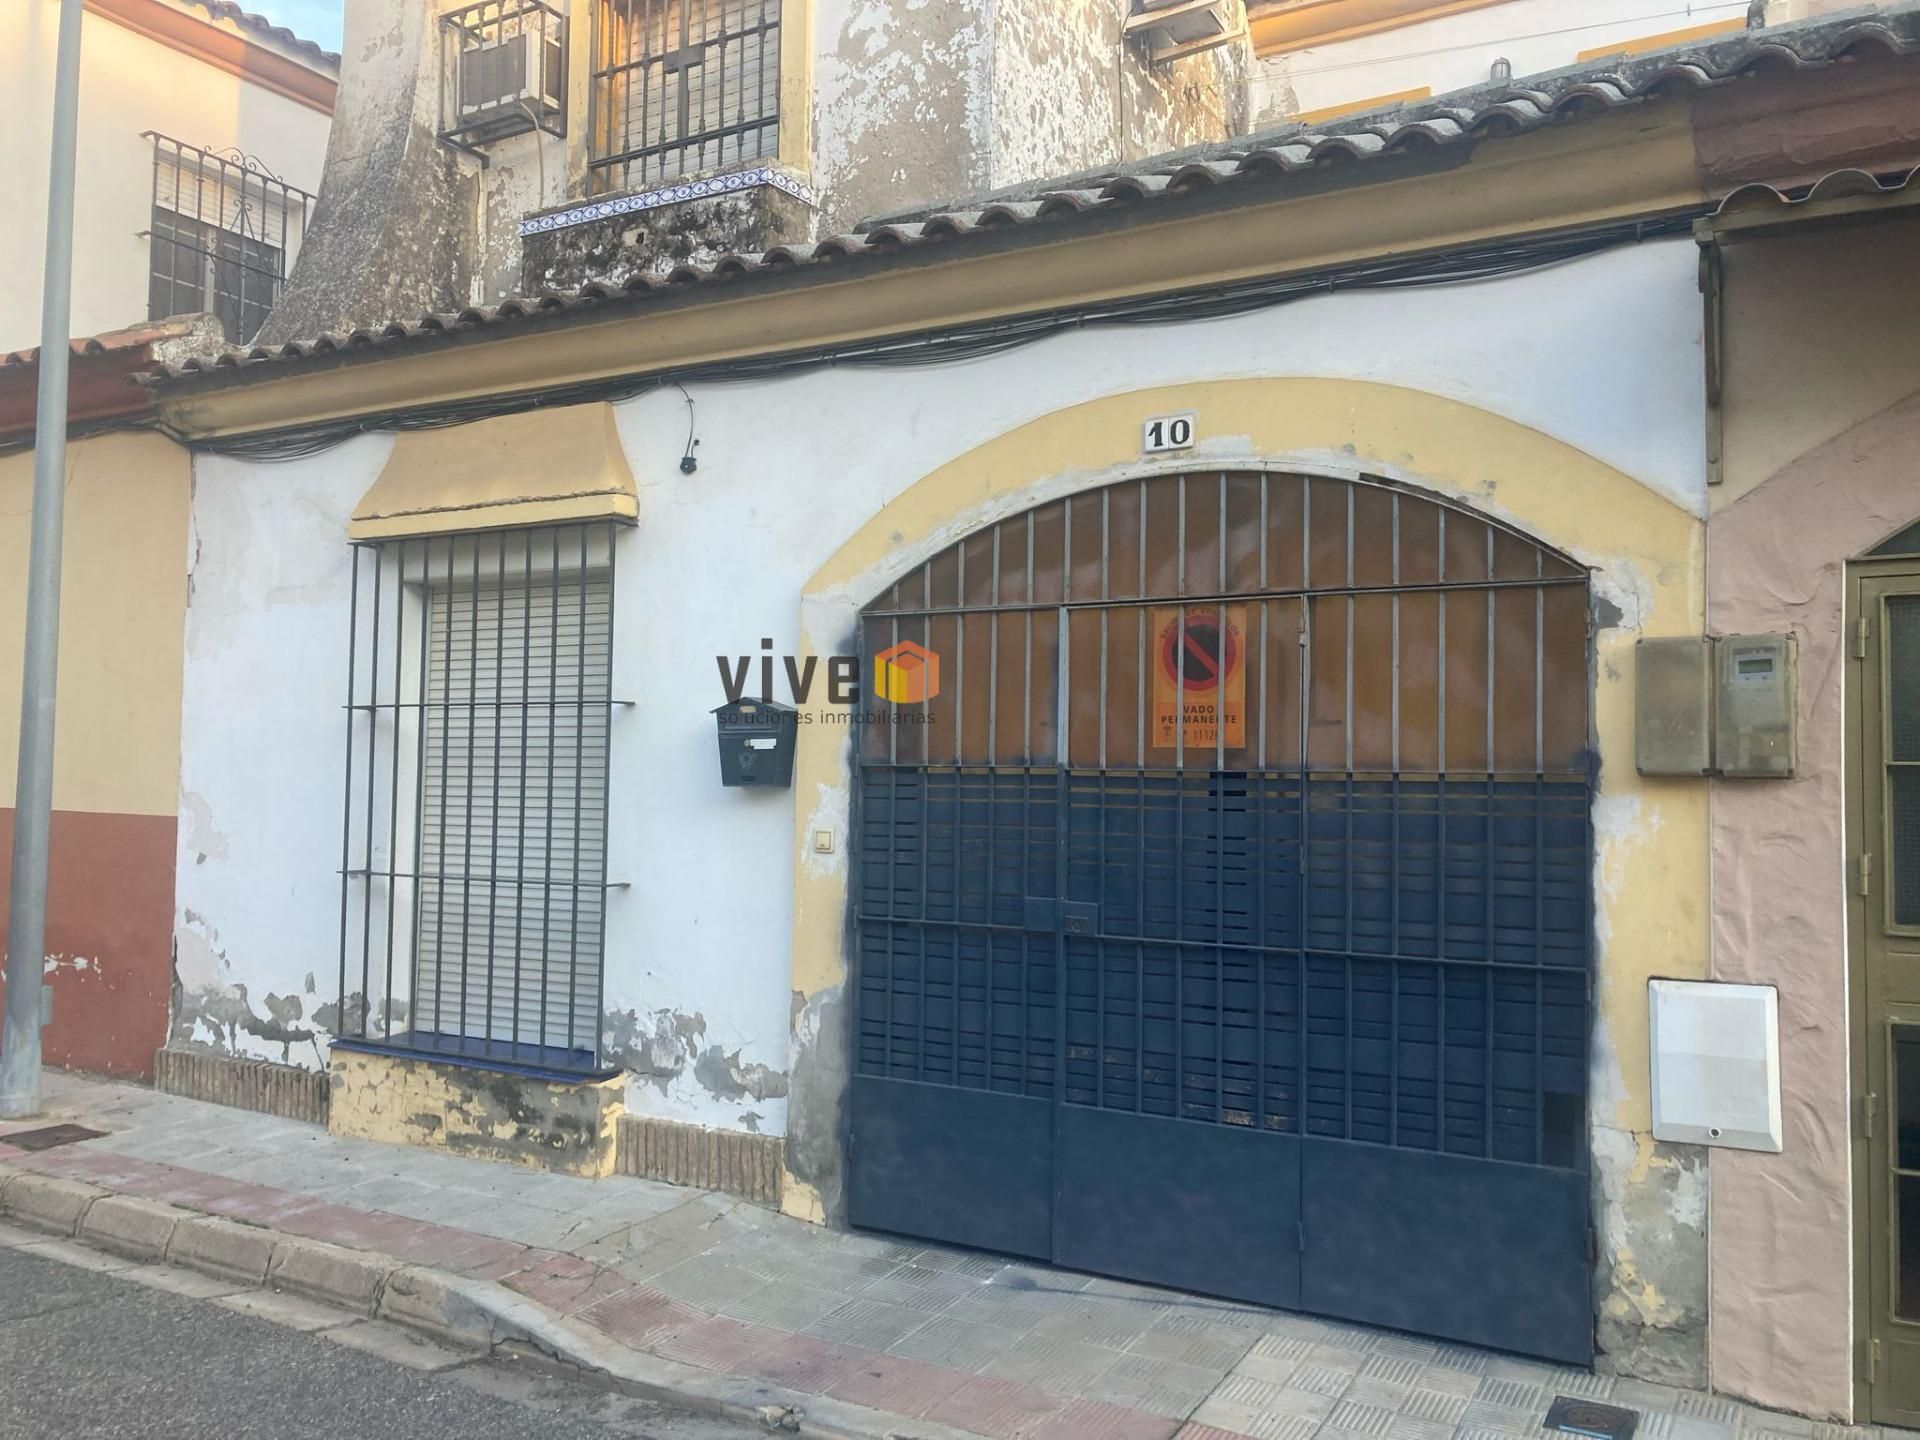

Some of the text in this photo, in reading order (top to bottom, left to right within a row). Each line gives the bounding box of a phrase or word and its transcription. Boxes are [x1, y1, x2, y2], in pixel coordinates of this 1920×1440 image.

[1148, 419, 1190, 447] 10
[1183, 705, 1215, 713] VADO
[1161, 715, 1238, 724] PEMANETE
